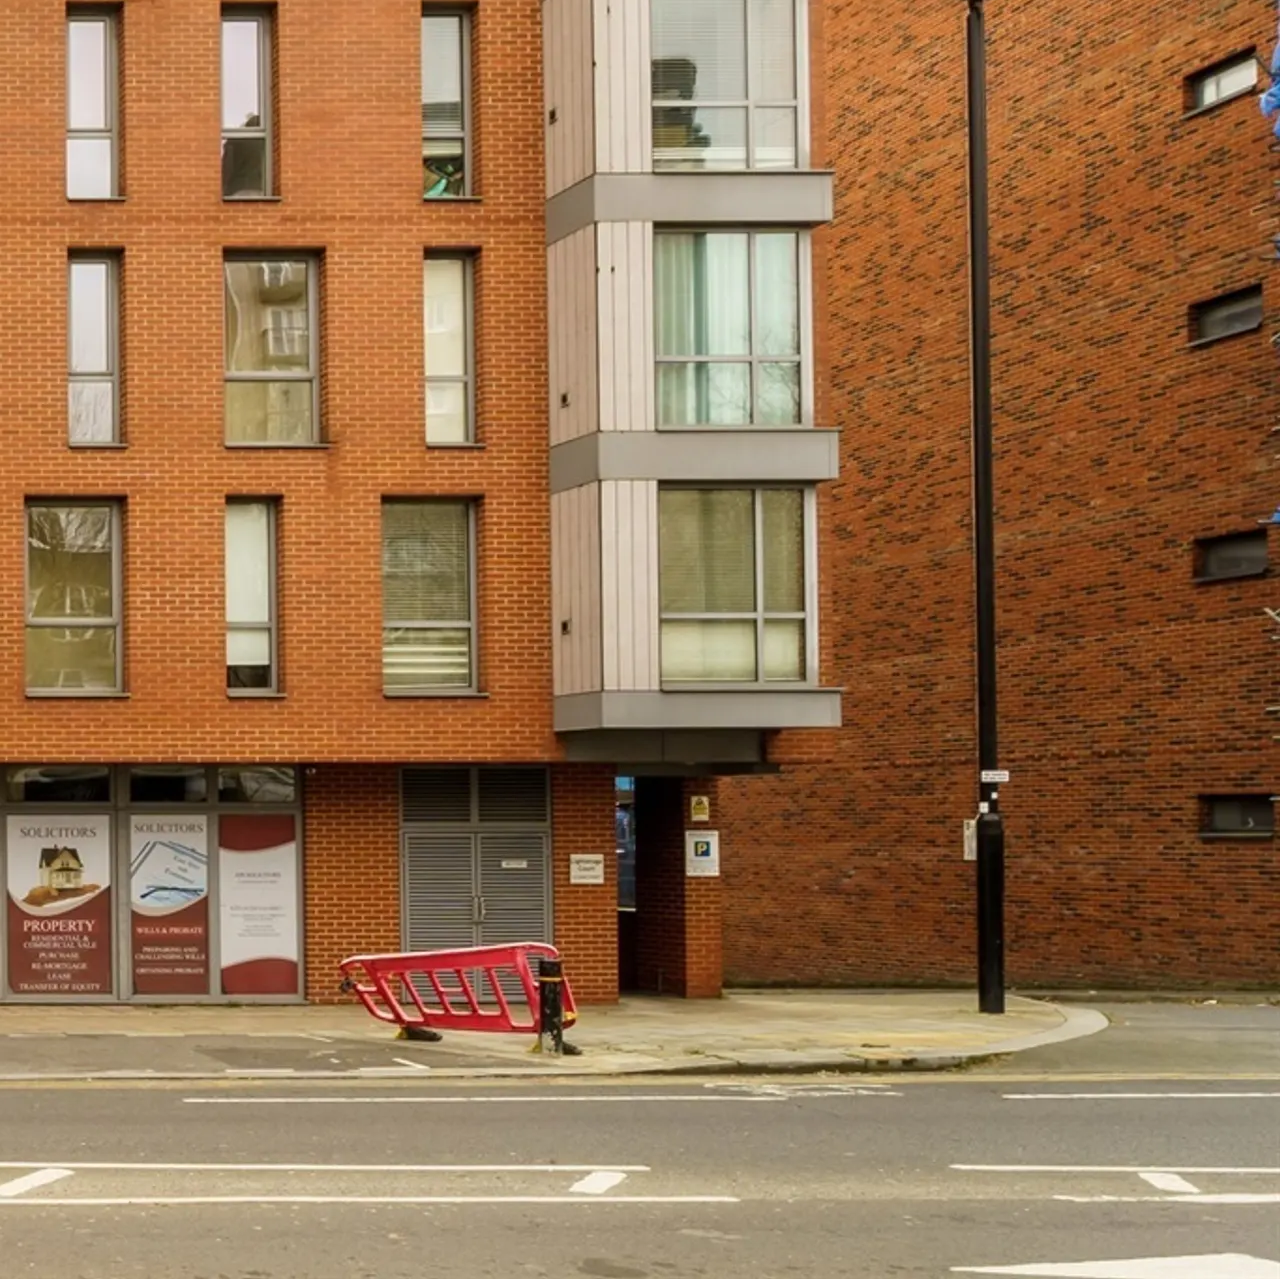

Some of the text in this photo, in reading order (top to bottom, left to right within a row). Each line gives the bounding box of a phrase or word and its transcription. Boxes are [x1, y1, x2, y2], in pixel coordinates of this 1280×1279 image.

[19, 827, 96, 838] SOLICITORS
[133, 823, 204, 833] SOLICITORS
[23, 919, 96, 932] PROPERTY
[19, 983, 101, 991] TRANSFER OF EQUITY
